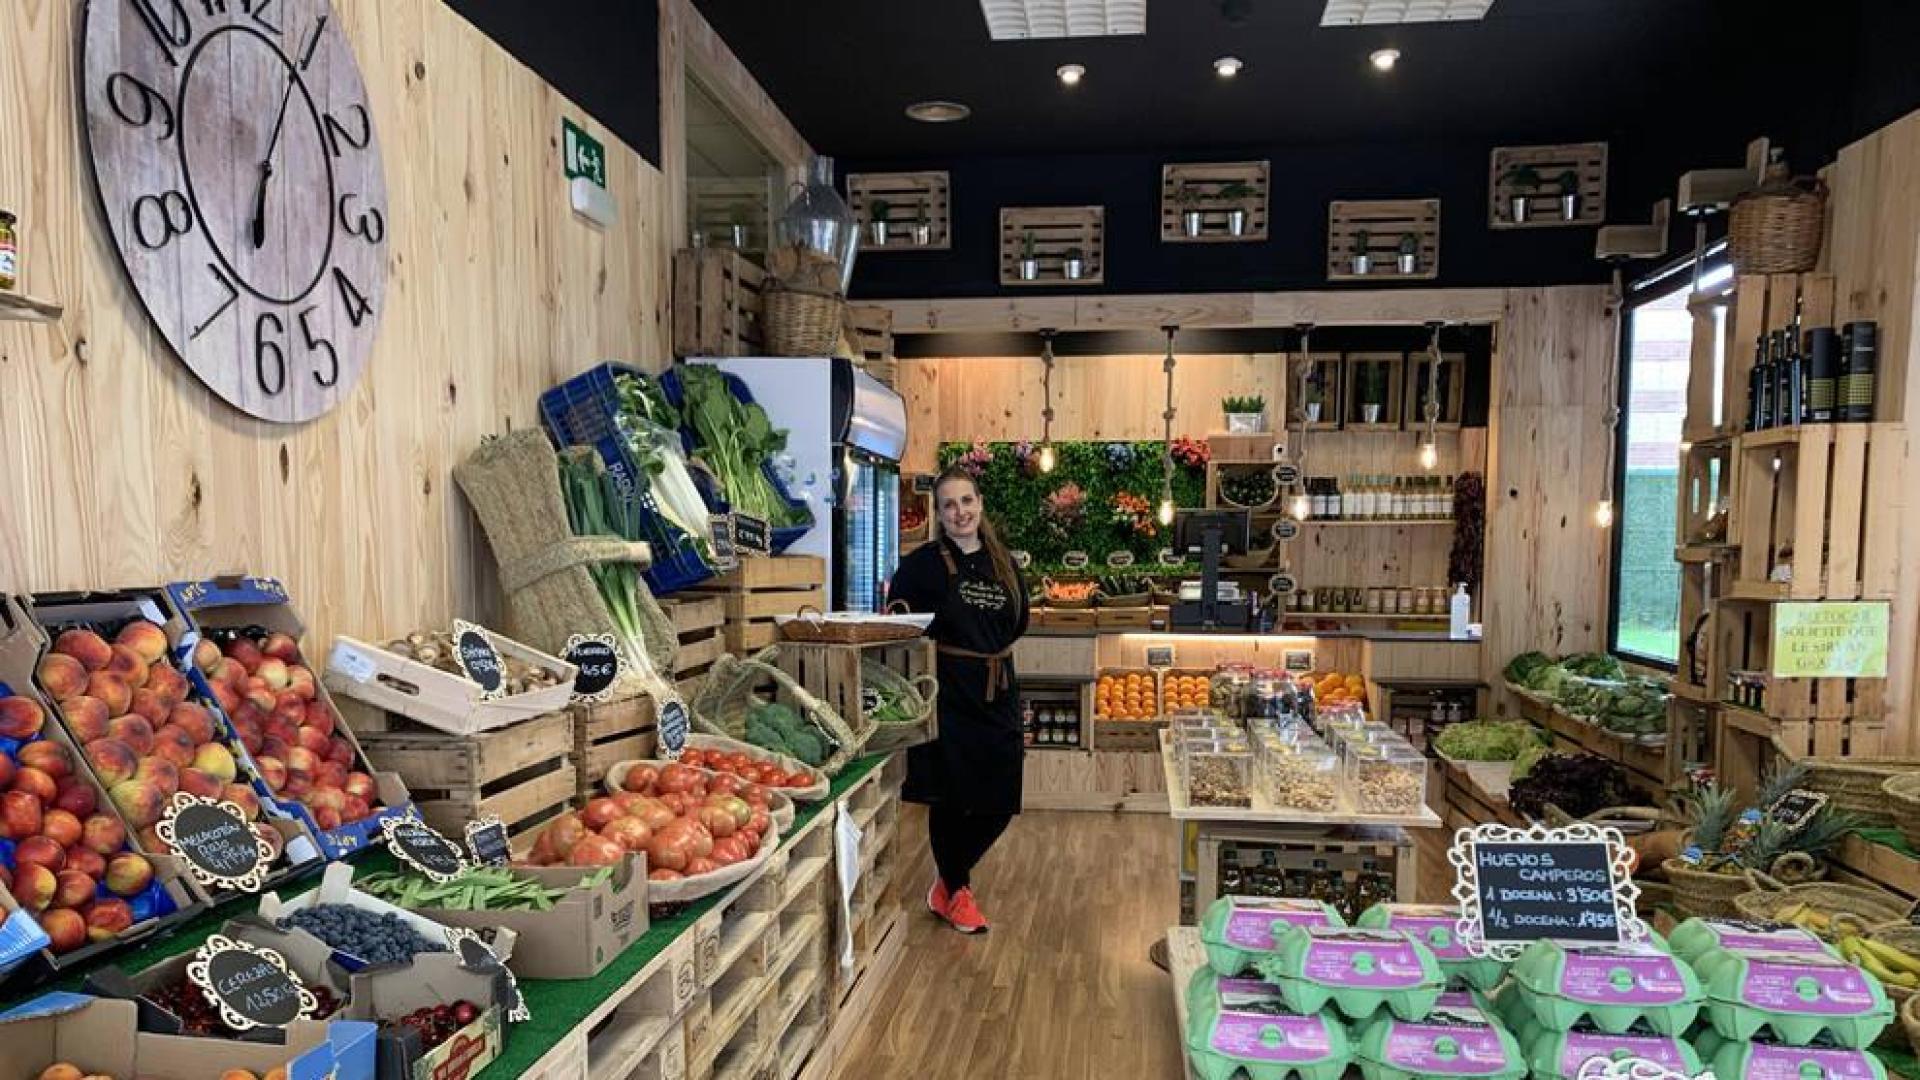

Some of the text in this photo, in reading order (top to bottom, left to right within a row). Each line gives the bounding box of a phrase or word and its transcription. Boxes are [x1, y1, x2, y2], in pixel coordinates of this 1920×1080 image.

[106, 72, 176, 140] 9
[323, 104, 371, 157] 2
[132, 190, 193, 249] 8
[338, 194, 384, 245] 3
[190, 263, 240, 340] 7
[332, 266, 373, 328] 4
[254, 312, 286, 395] 6
[299, 307, 339, 387] 5
[1479, 852, 1555, 868] HUEVOS
[1519, 868, 1606, 883] CAMPEROS
[1486, 886, 1495, 901] 1
